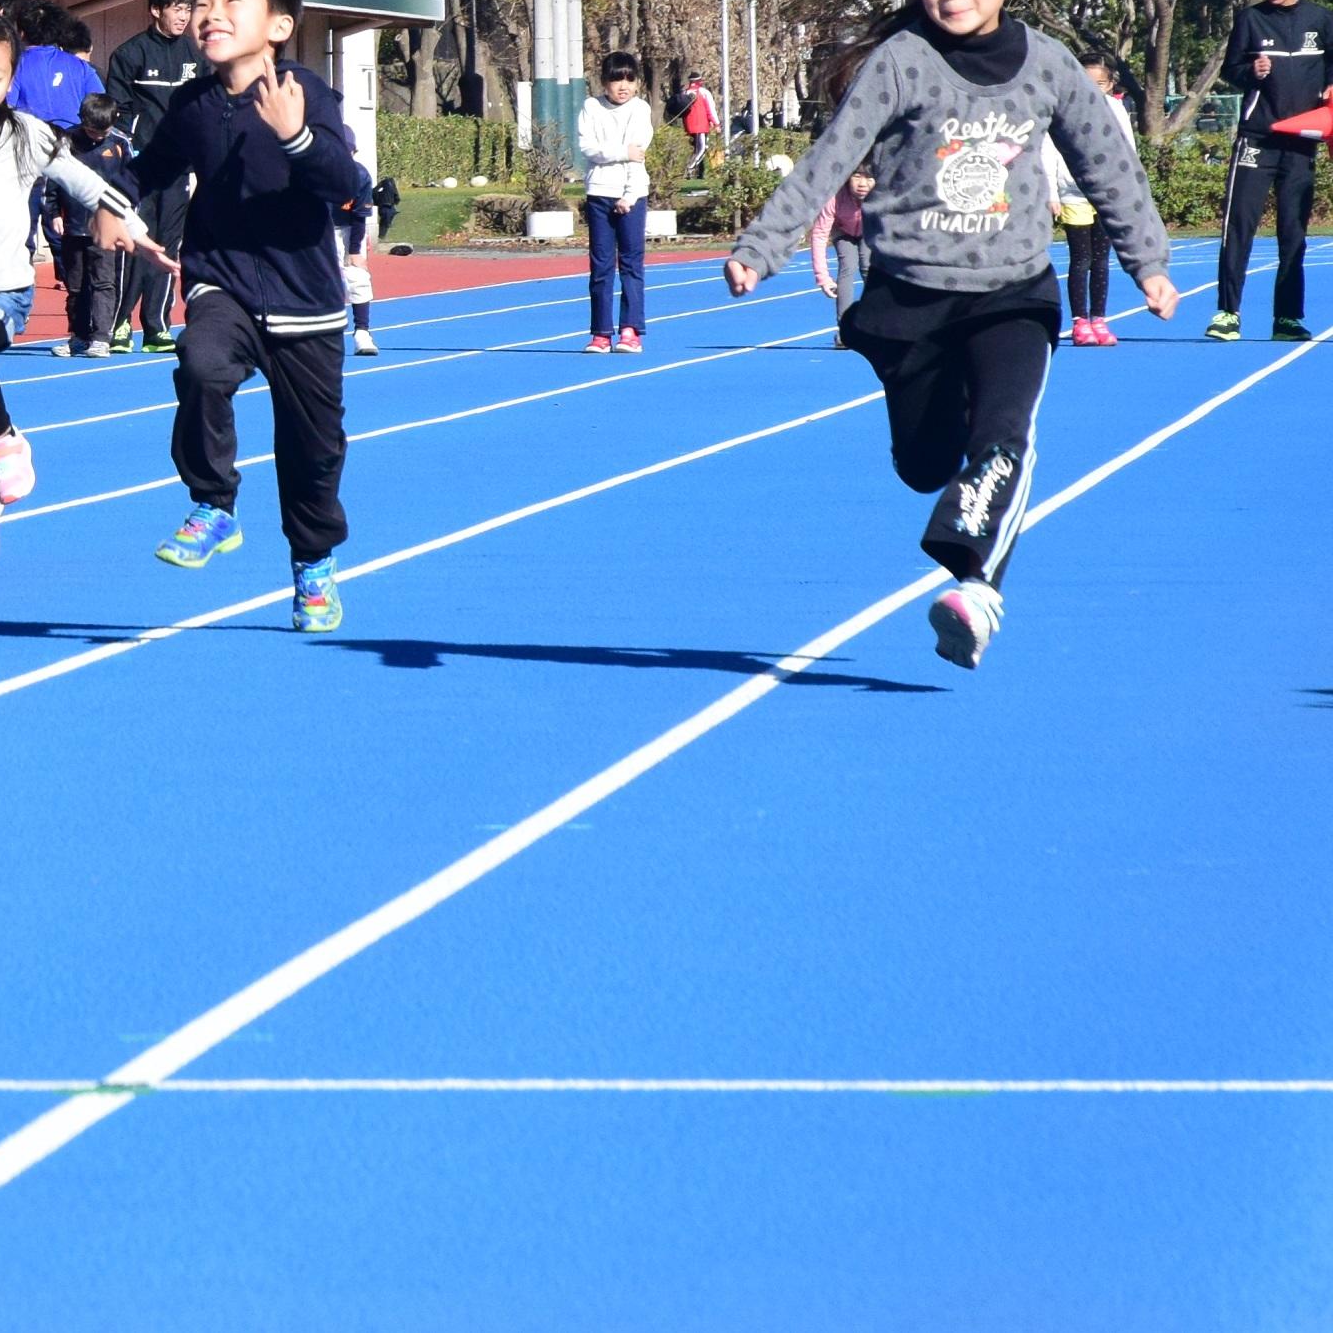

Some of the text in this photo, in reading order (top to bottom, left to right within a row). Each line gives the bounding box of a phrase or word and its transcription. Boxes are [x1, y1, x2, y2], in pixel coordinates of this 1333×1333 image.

[1302, 31, 1319, 48] K
[181, 62, 197, 79] K
[938, 110, 1035, 145] Restful
[1240, 147, 1262, 164] K
[920, 209, 1010, 235] VIVACITY
